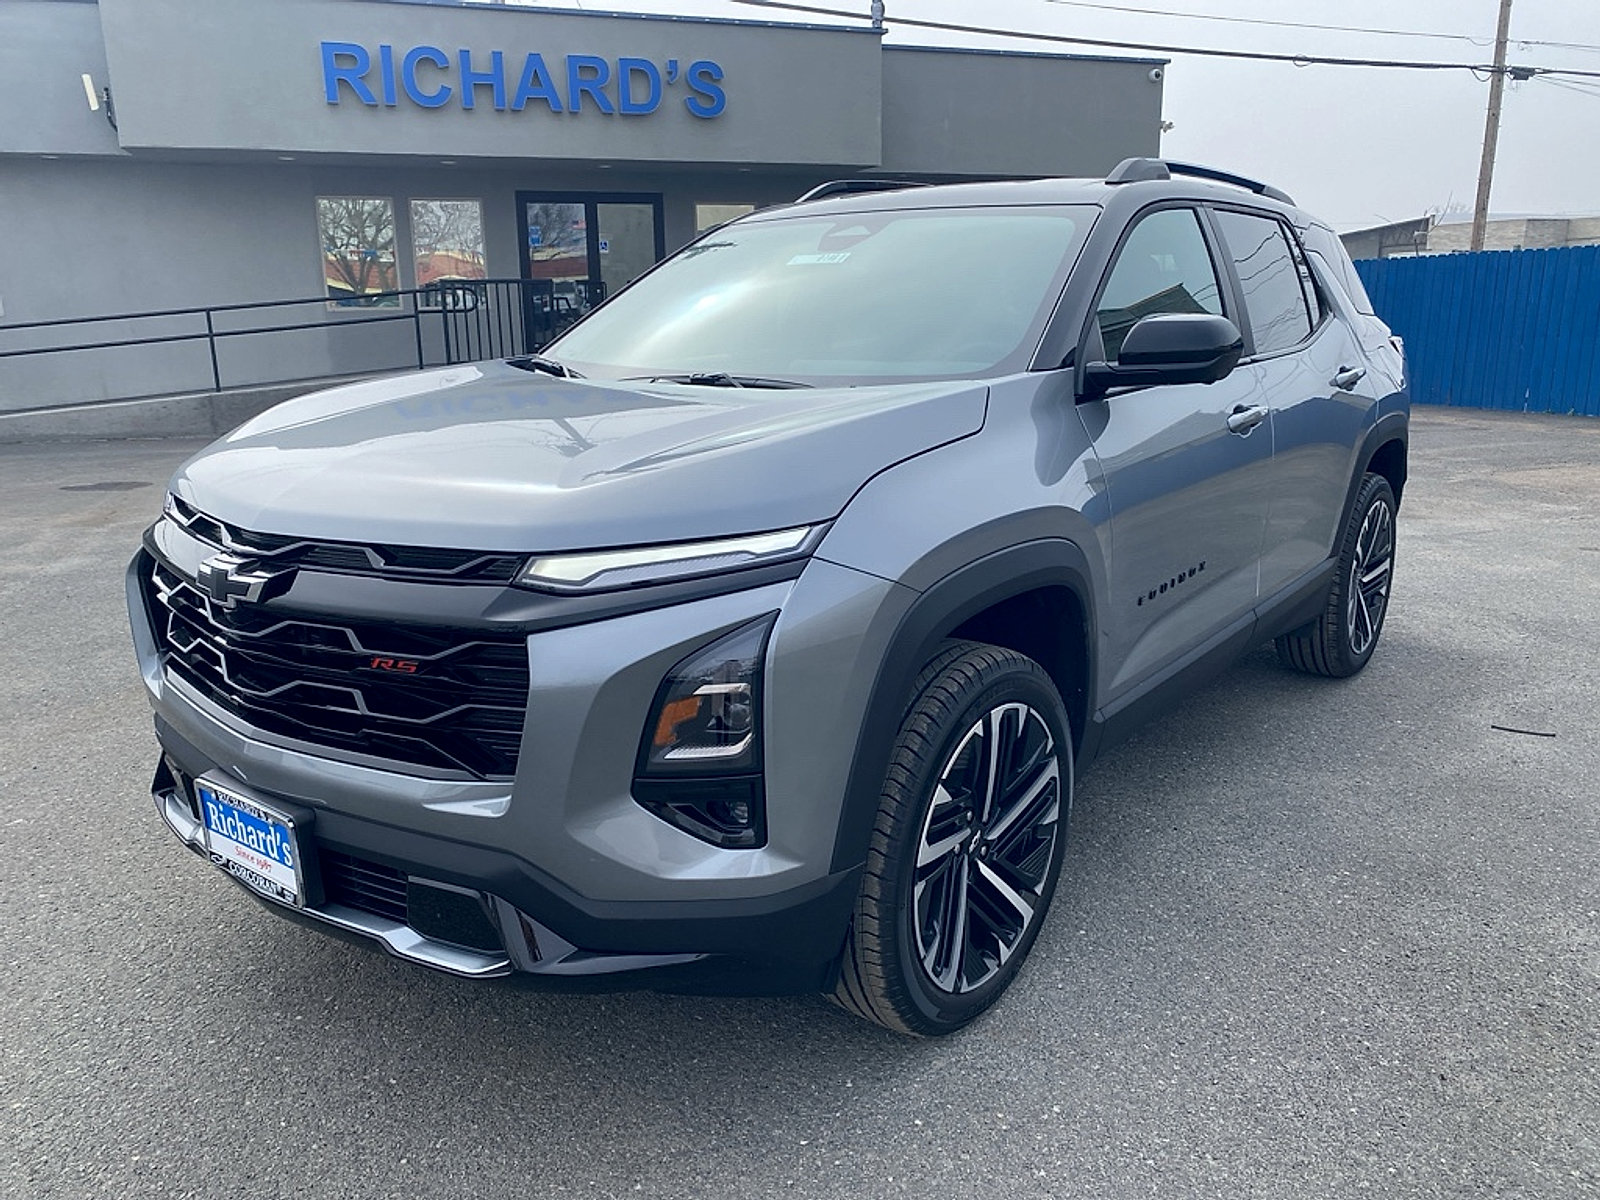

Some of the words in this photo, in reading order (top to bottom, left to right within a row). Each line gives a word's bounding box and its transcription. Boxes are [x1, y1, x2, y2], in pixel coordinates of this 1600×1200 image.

[320, 41, 728, 118] RICHARD'S
[370, 656, 418, 673] RS
[206, 801, 292, 867] Richard's
